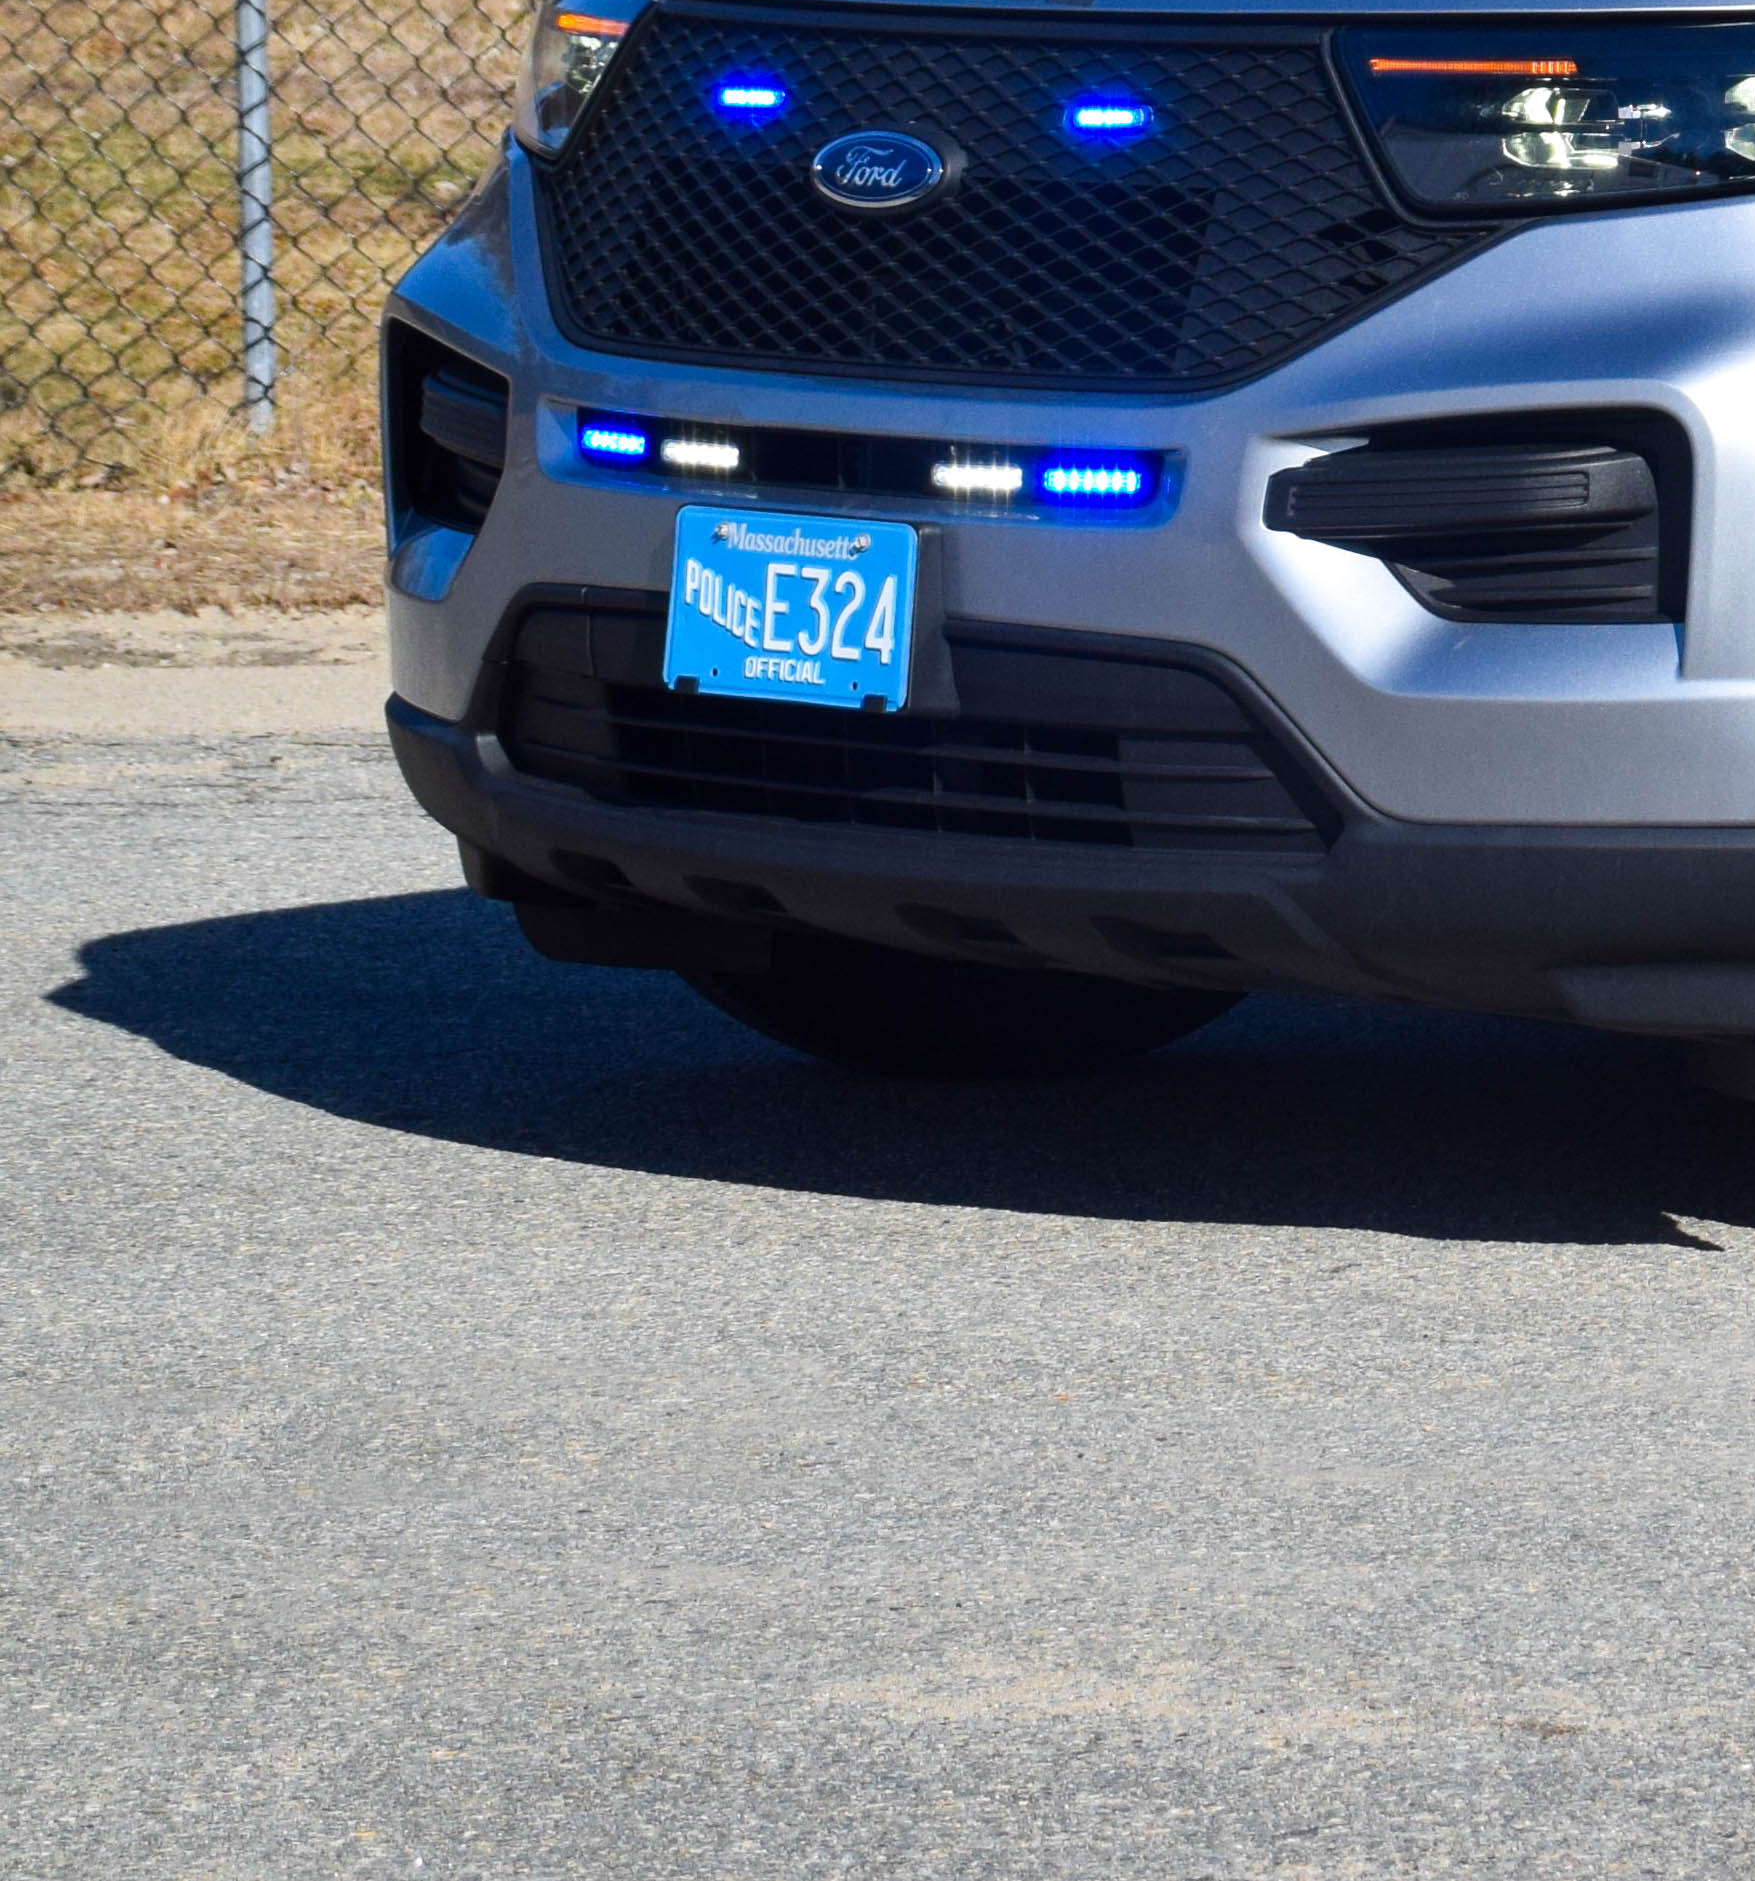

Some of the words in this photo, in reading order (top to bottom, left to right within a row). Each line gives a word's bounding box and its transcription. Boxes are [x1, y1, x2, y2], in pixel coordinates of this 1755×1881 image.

[836, 144, 907, 188] Ford
[684, 558, 762, 649] POLICE
[762, 562, 898, 665] E324
[744, 655, 826, 685] OFFICIAL
